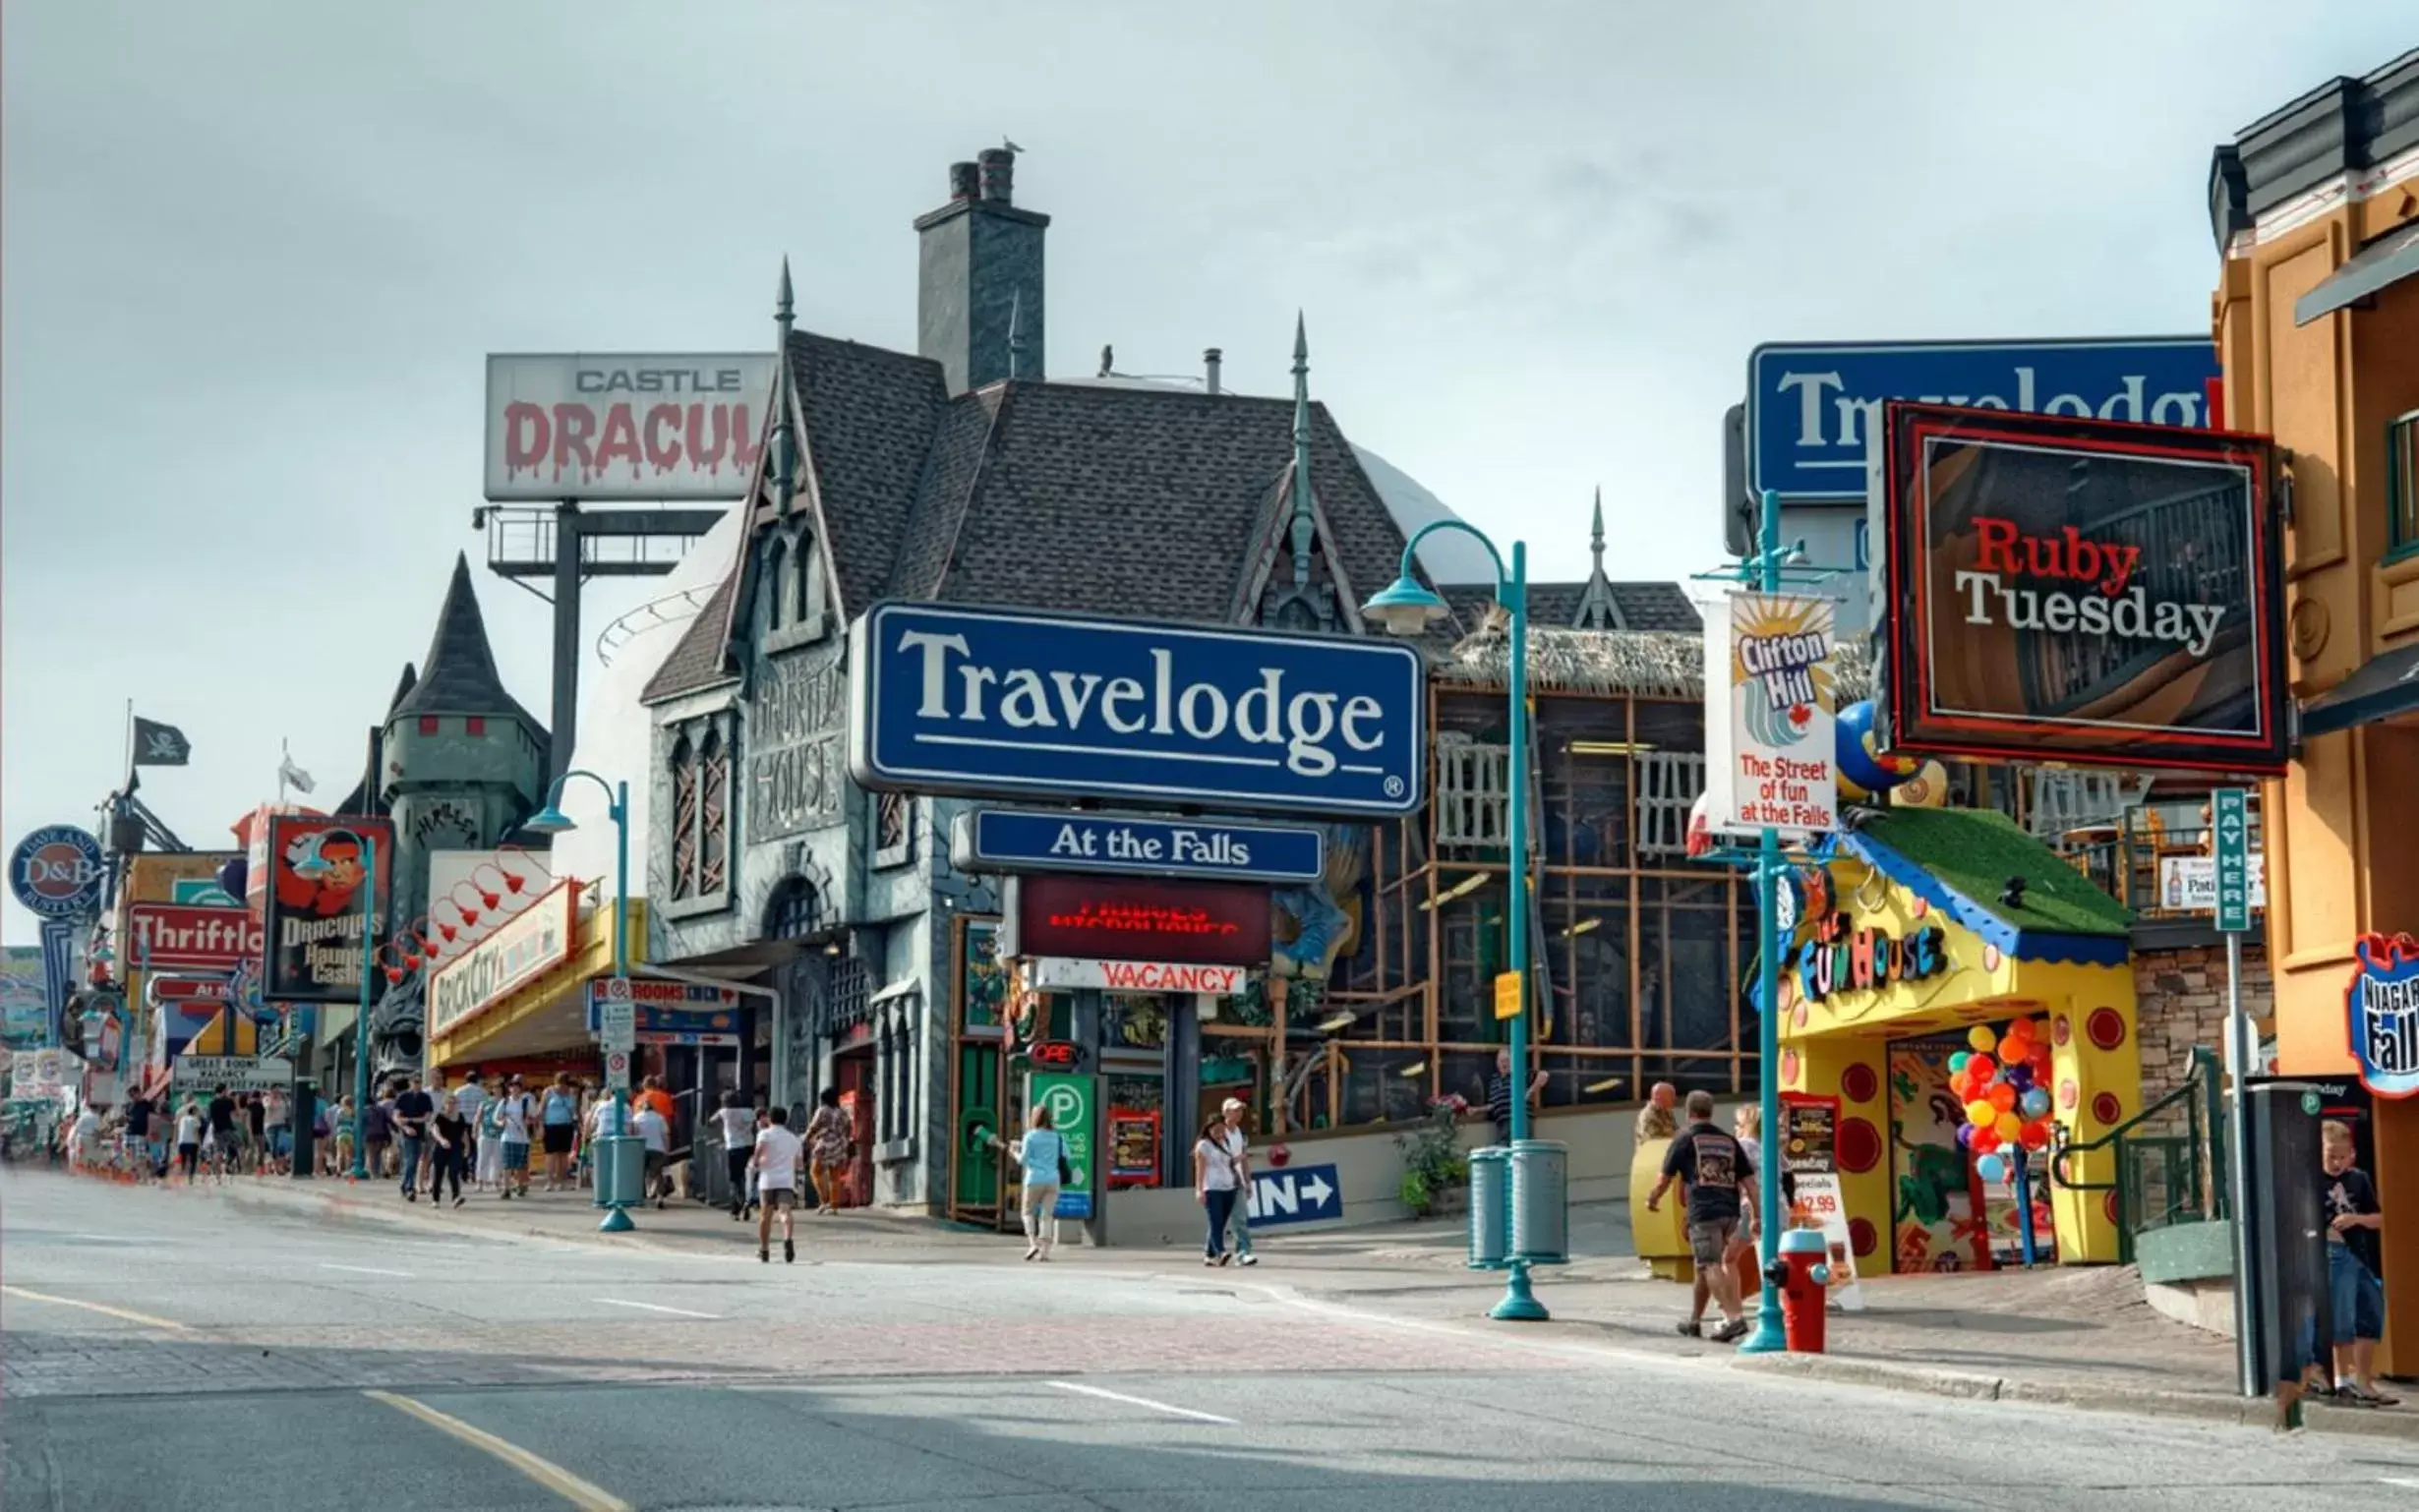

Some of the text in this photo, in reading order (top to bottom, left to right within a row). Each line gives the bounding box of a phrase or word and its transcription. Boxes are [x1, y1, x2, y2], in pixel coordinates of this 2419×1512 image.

[576, 370, 741, 393] CASTLE
[1972, 517, 2140, 596] Ruby
[1955, 571, 2225, 657] Tuesday
[1740, 632, 1826, 676] Clifton
[897, 630, 1385, 777] Travelodge
[1766, 668, 1815, 711] Hill
[1740, 755, 1828, 782] The Street
[1760, 781, 1808, 802] of fun
[1740, 803, 1830, 828] at the Falls
[1049, 824, 1251, 865] At the Falls
[2220, 796, 2243, 920] PAY HERE
[21, 857, 94, 885] D&B
[1101, 962, 1239, 992] VACANCY
[1800, 927, 1934, 1002] FUN HOUSE
[1034, 1045, 1071, 1062] OPE
[1246, 1175, 1299, 1218] IN
